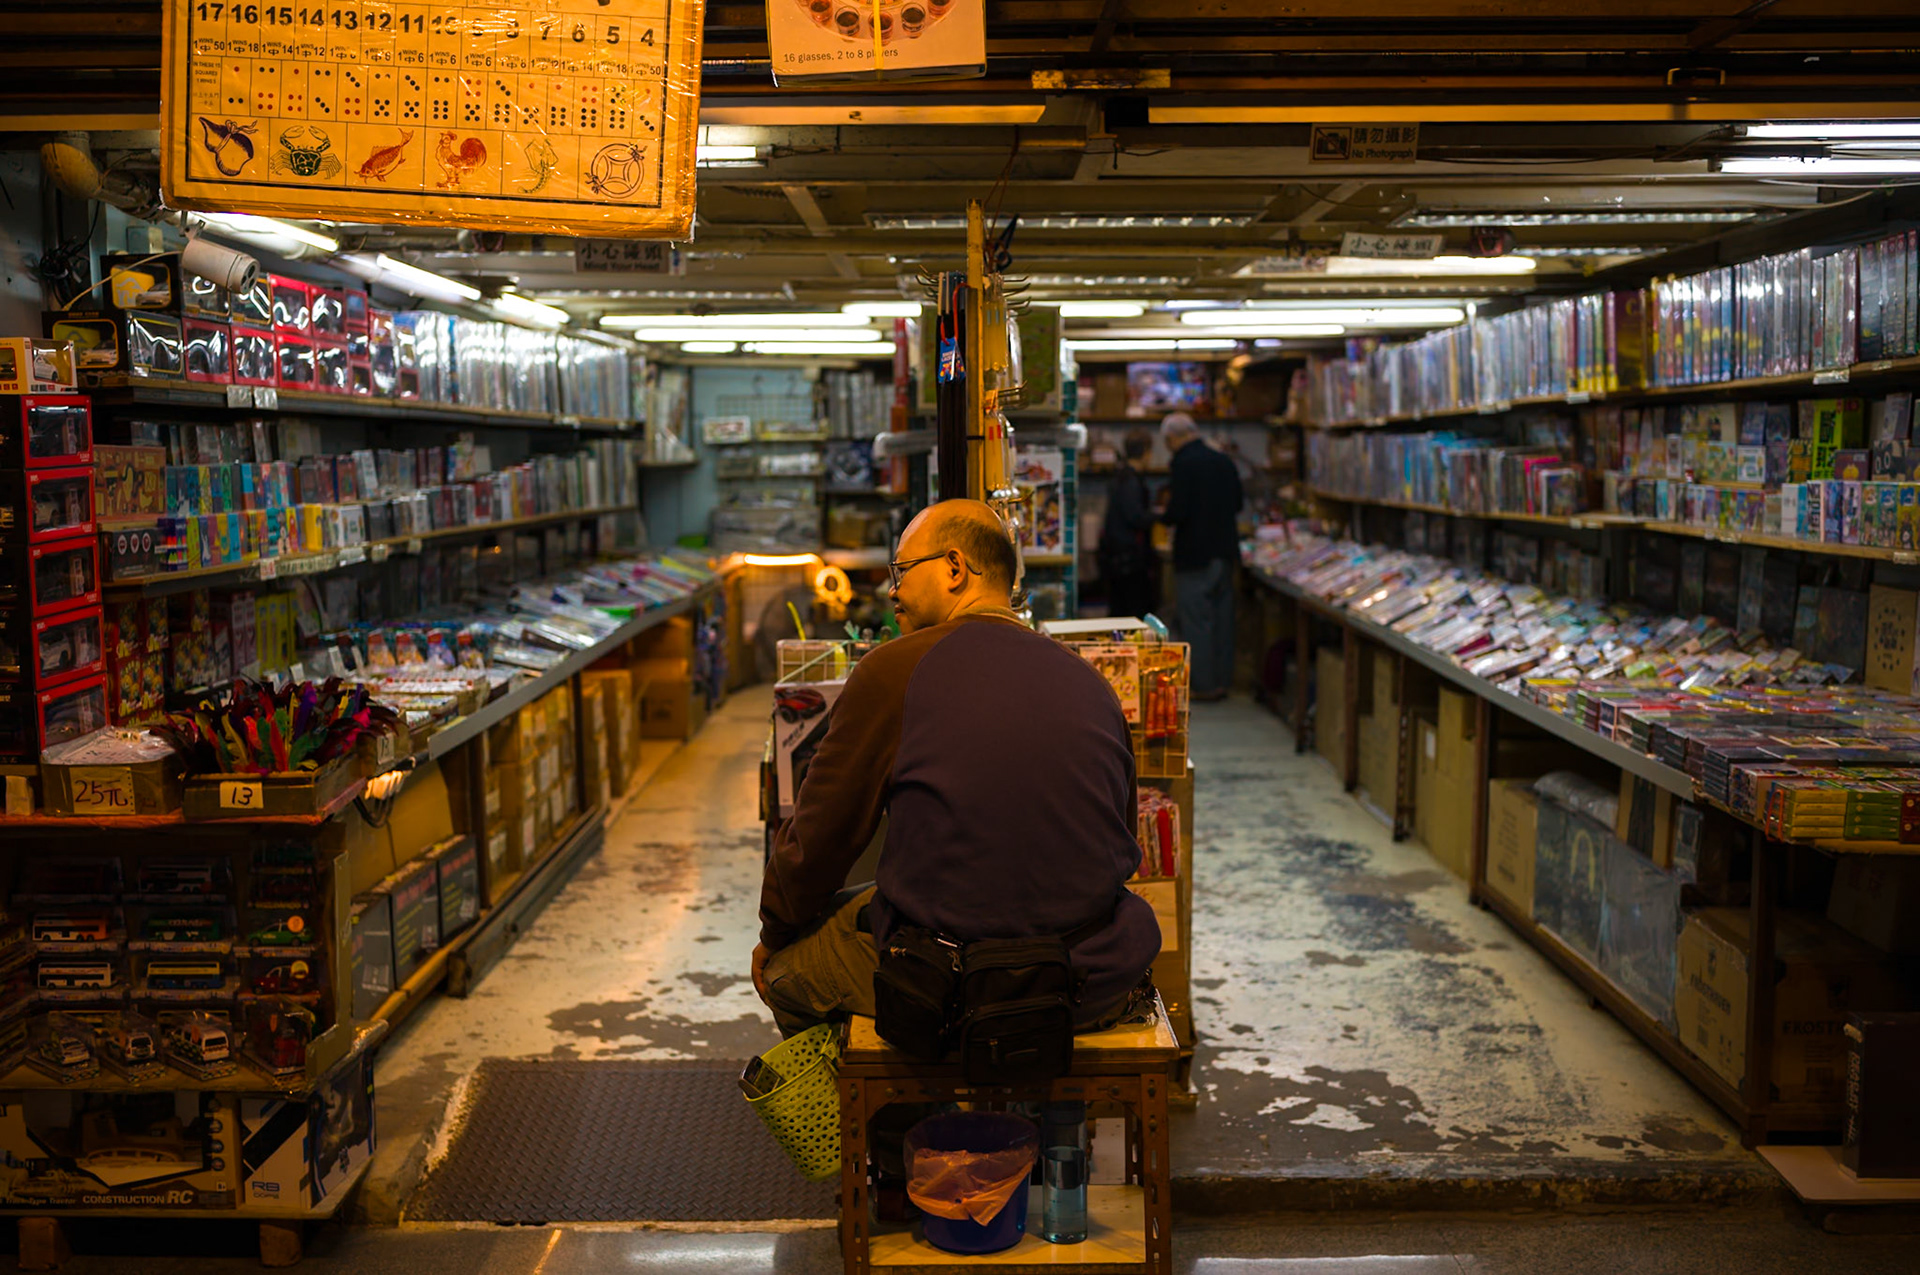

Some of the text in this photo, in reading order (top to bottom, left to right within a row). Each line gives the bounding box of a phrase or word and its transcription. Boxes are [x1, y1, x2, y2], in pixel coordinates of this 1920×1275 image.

[197, 3, 224, 22] 17
[231, 4, 259, 24] 16
[265, 6, 293, 26] 15
[298, 8, 324, 27] 14
[331, 10, 358, 30] 13
[365, 12, 391, 32] 12
[400, 14, 424, 33] 11
[432, 15, 457, 35] 10
[540, 22, 553, 40] 7
[572, 24, 585, 43] 6
[606, 26, 620, 44] 5
[640, 28, 655, 47] 4
[214, 41, 225, 51] 50
[248, 43, 259, 53] 18
[282, 44, 293, 54] 14
[314, 47, 325, 56] 12
[783, 48, 899, 64] 16 glasses, 2 to 8 plers
[418, 52, 424, 63] 6
[450, 54, 456, 64] 6
[485, 56, 492, 66] 6
[616, 64, 627, 73] 18
[650, 65, 661, 75] 50
[1352, 149, 1364, 158] No
[230, 786, 254, 806] 13
[82, 1194, 166, 1204] CONSTRUCTION
[166, 1189, 194, 1204] RC
